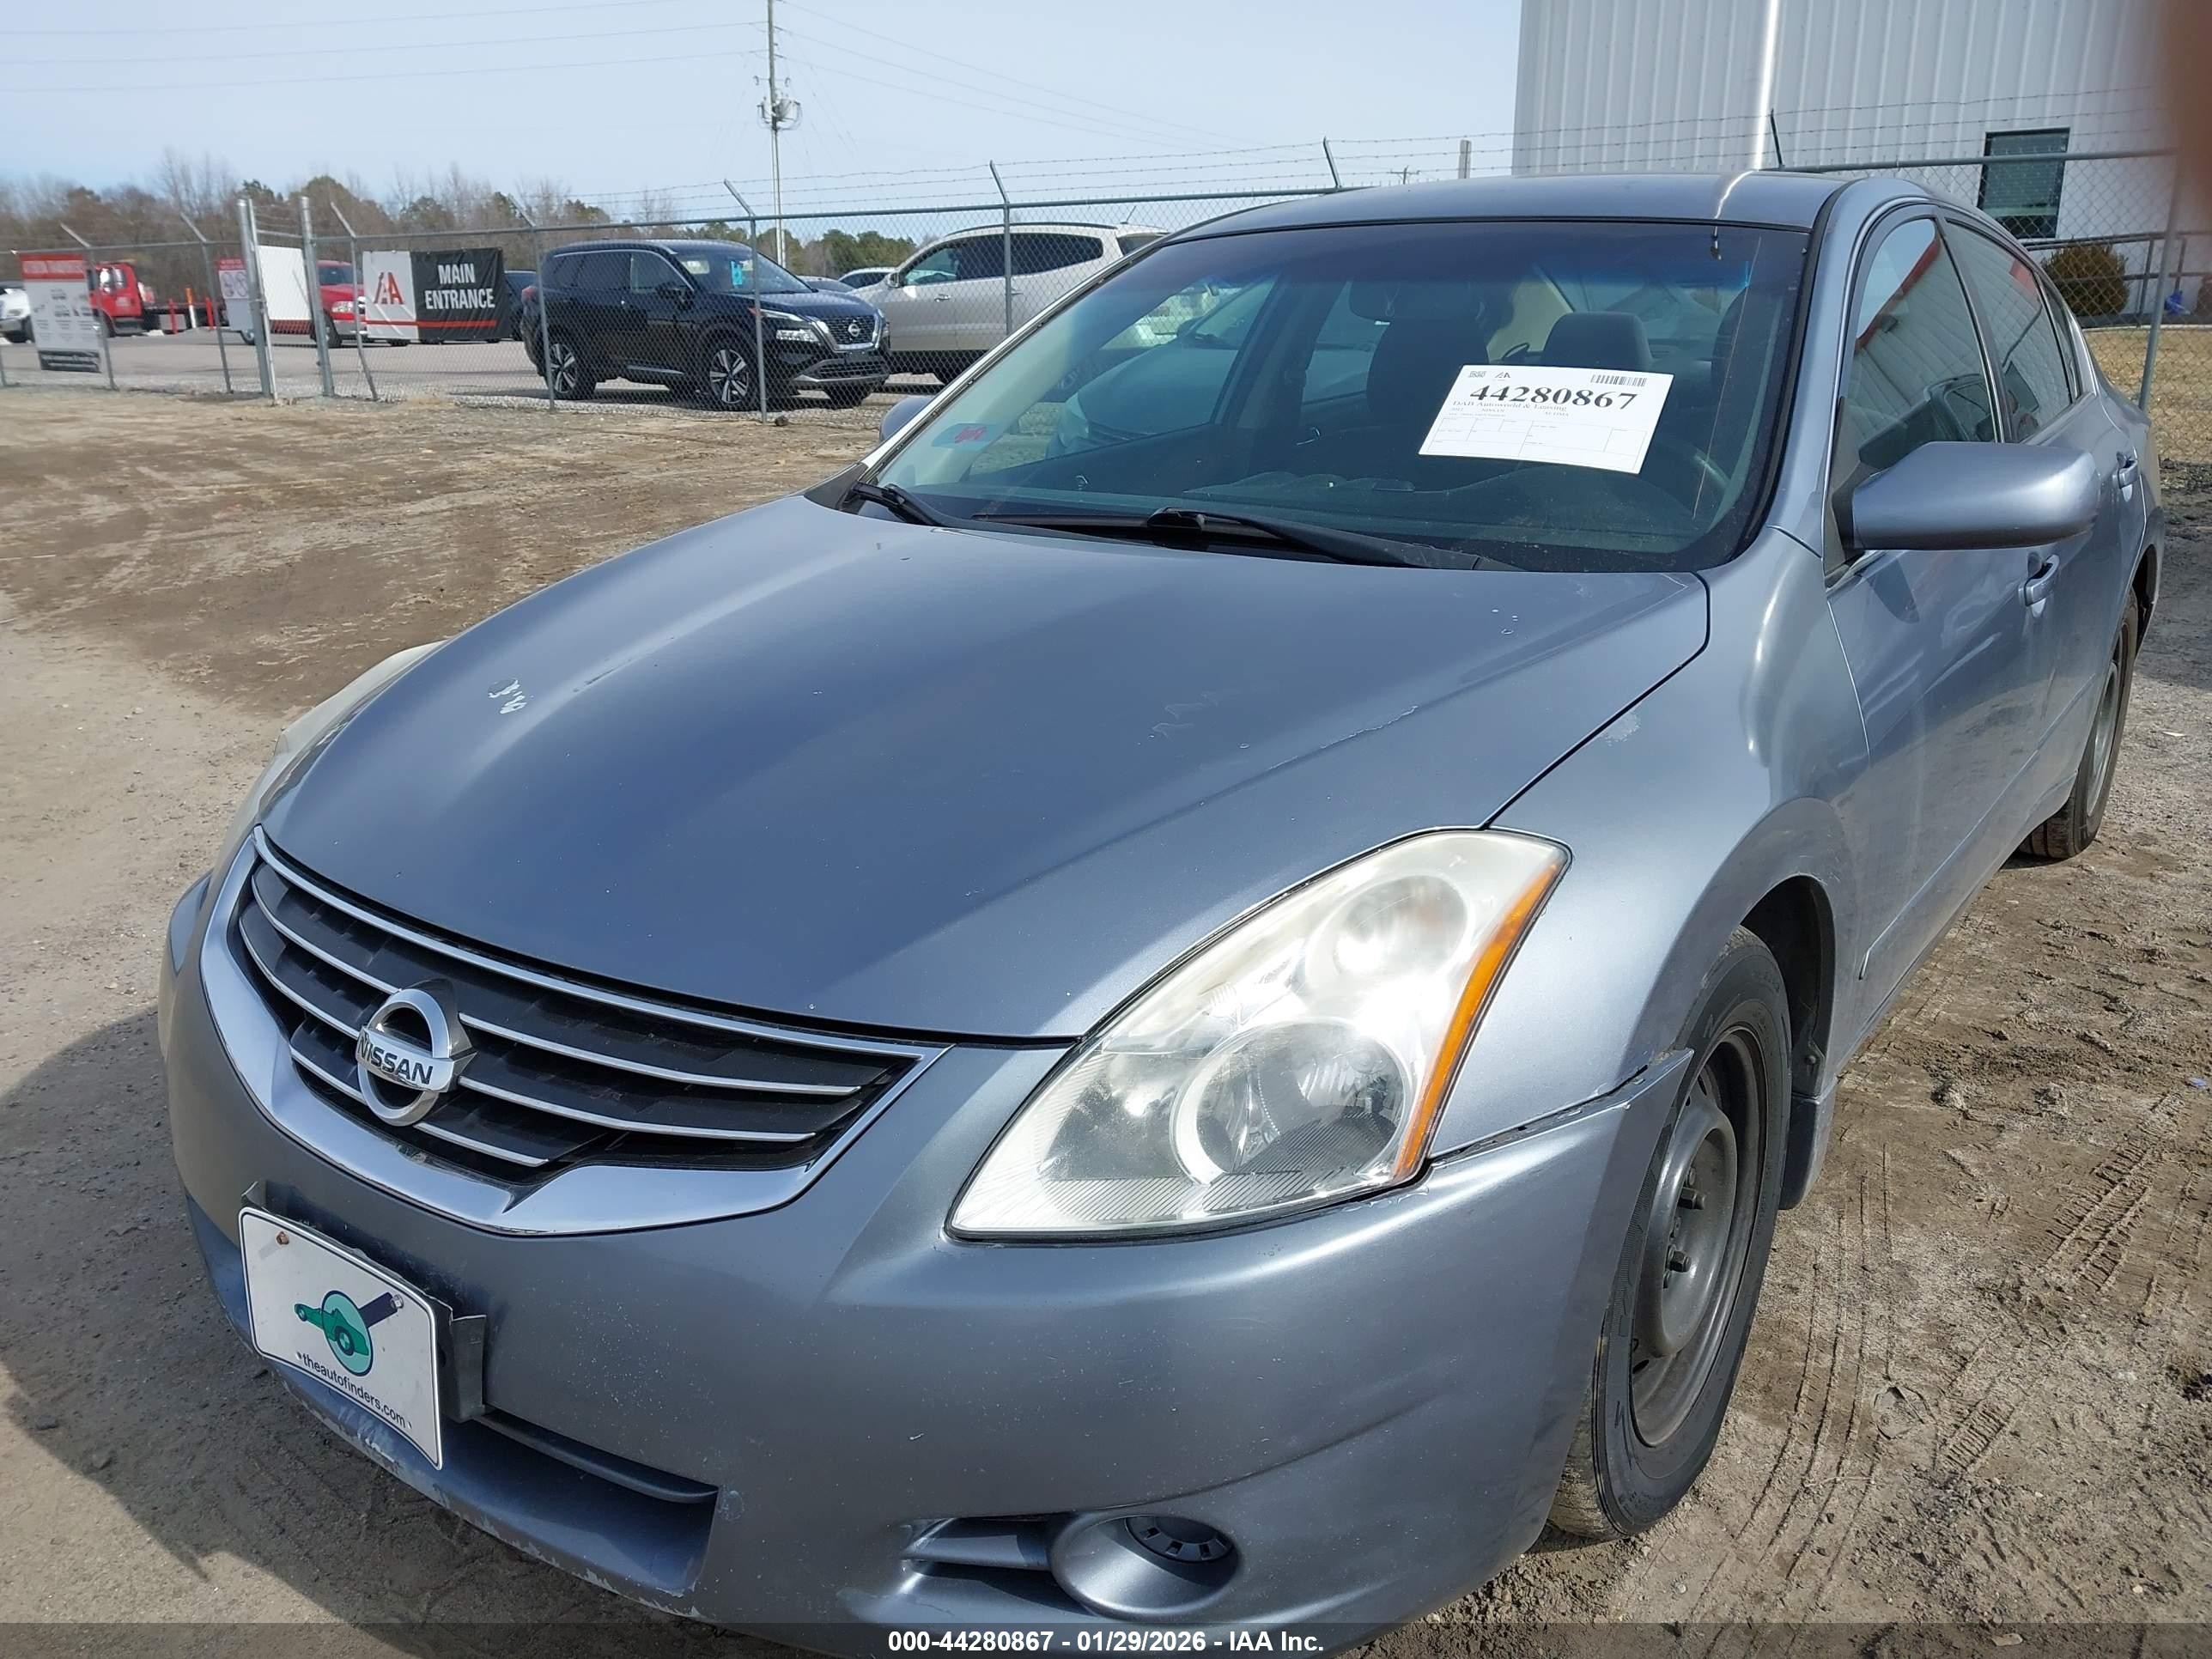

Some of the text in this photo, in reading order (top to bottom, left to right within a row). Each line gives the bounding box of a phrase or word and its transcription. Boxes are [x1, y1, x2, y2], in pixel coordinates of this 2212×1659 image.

[438, 263, 476, 284] MAIN
[424, 289, 495, 310] ENTRANCE
[1470, 385, 1638, 410] 44280867
[357, 1030, 434, 1085] NISSAN
[302, 1352, 406, 1429] theautofinders.com
